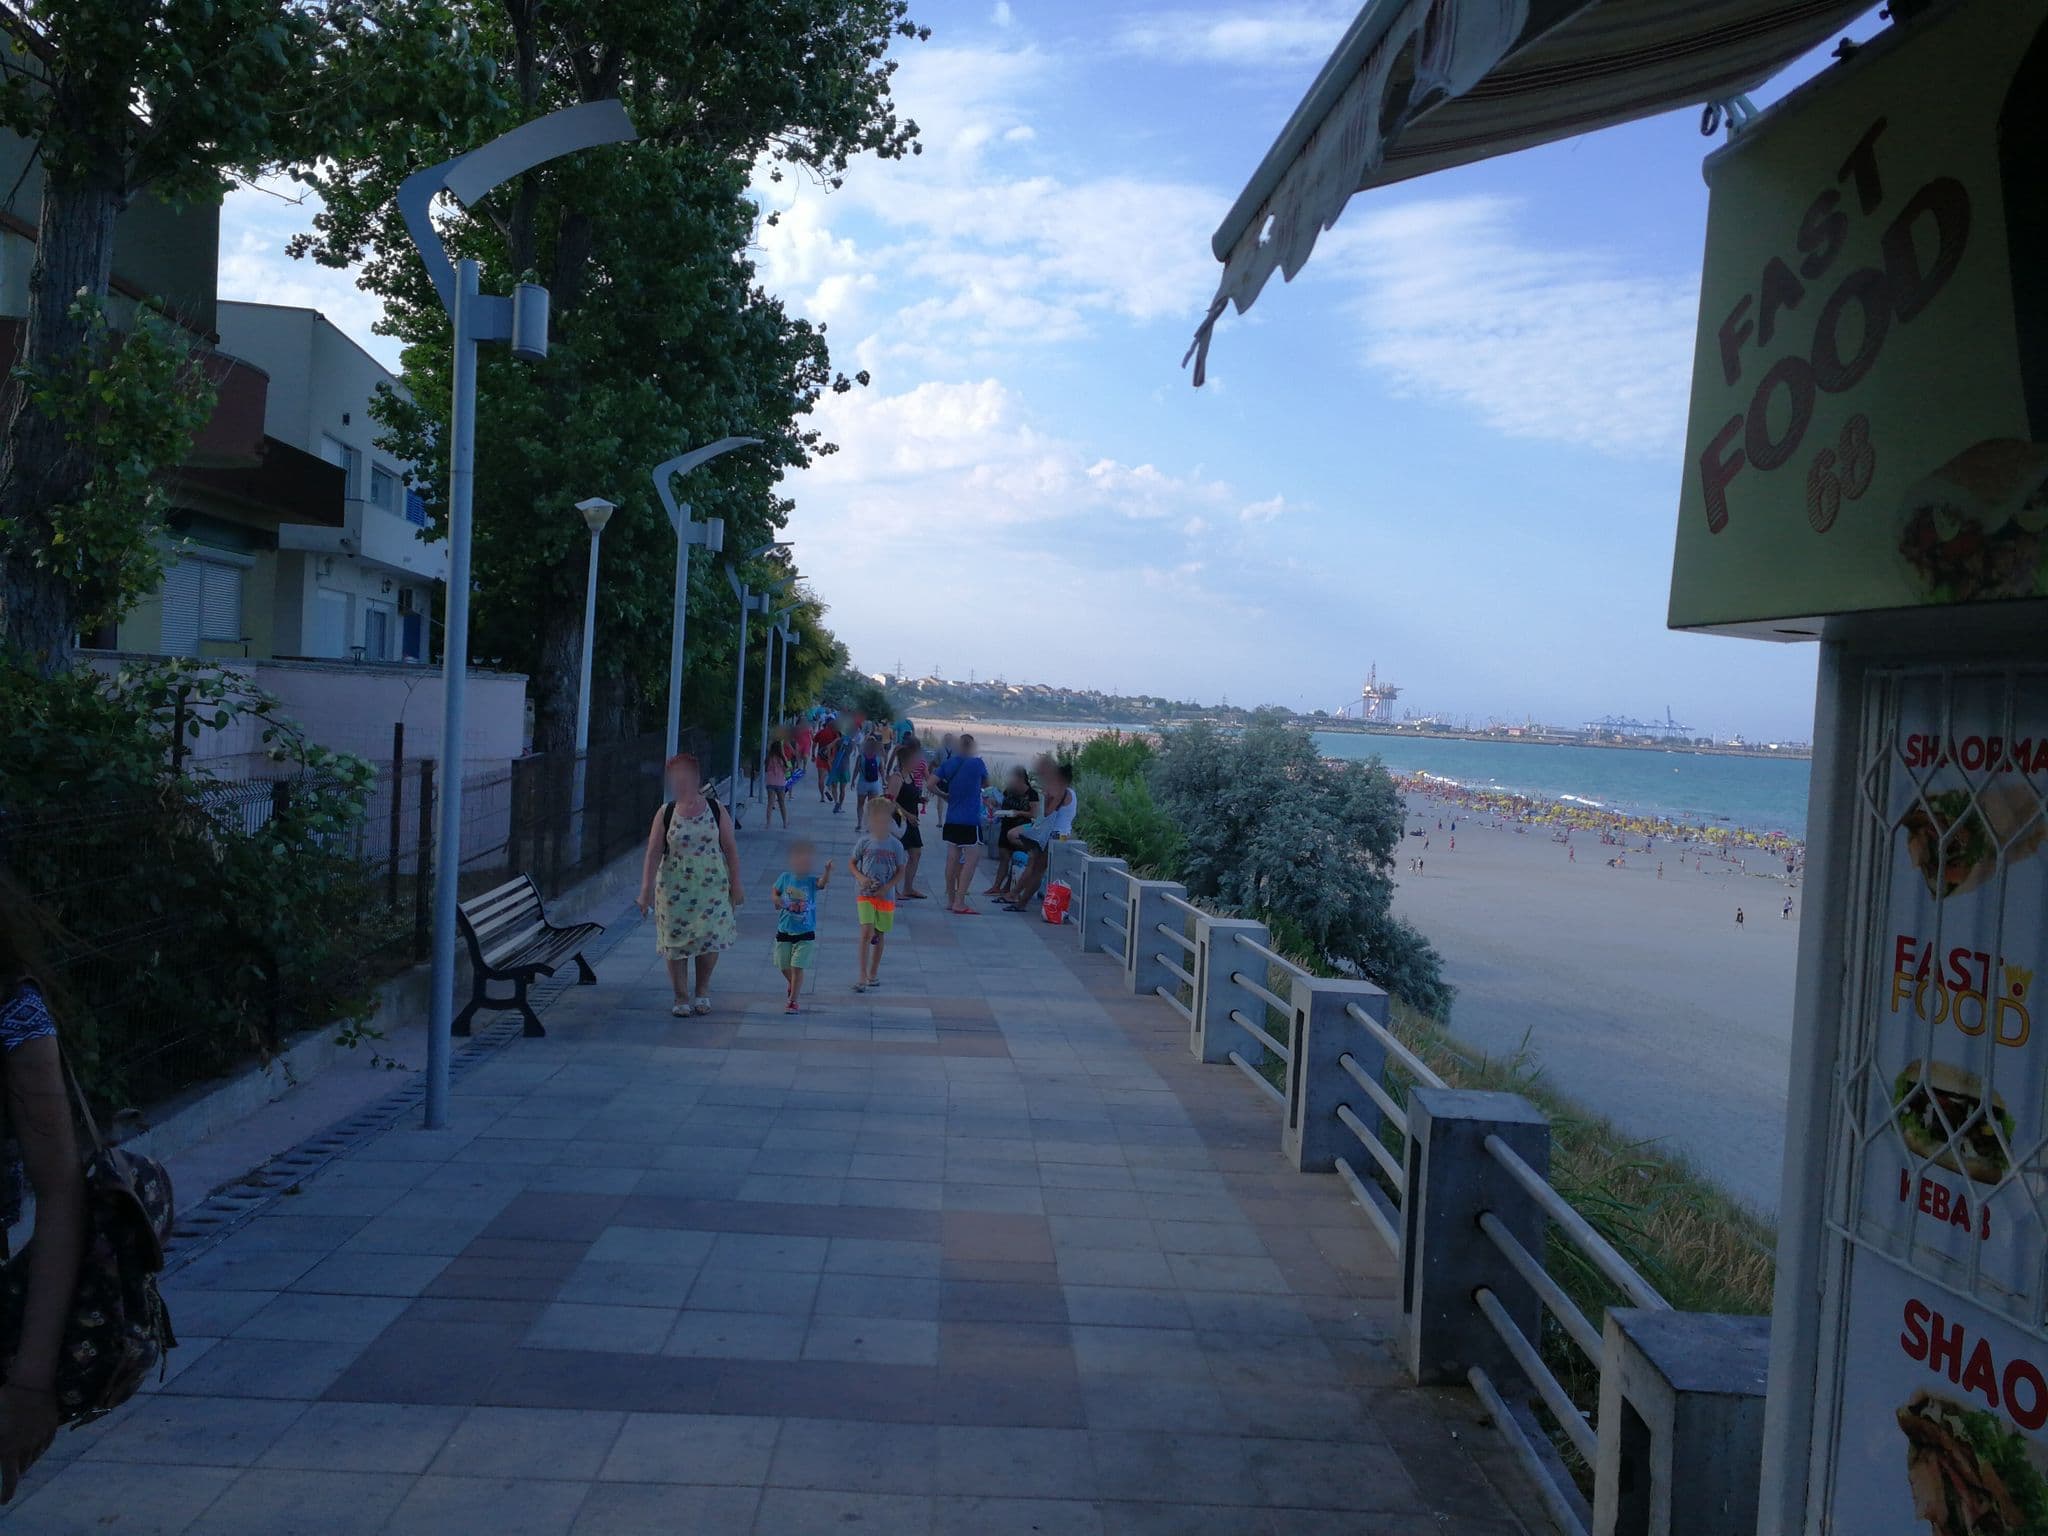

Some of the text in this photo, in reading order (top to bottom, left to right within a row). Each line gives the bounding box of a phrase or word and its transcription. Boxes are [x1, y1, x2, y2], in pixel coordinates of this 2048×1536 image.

[1718, 116, 1888, 387] FAST
[1700, 176, 1971, 534] FOOD
[1807, 413, 1876, 534] 68
[1892, 972, 2030, 1048] FOOD
[1895, 935, 2004, 1001] FAST
[1901, 1299, 2048, 1430] SHAO
